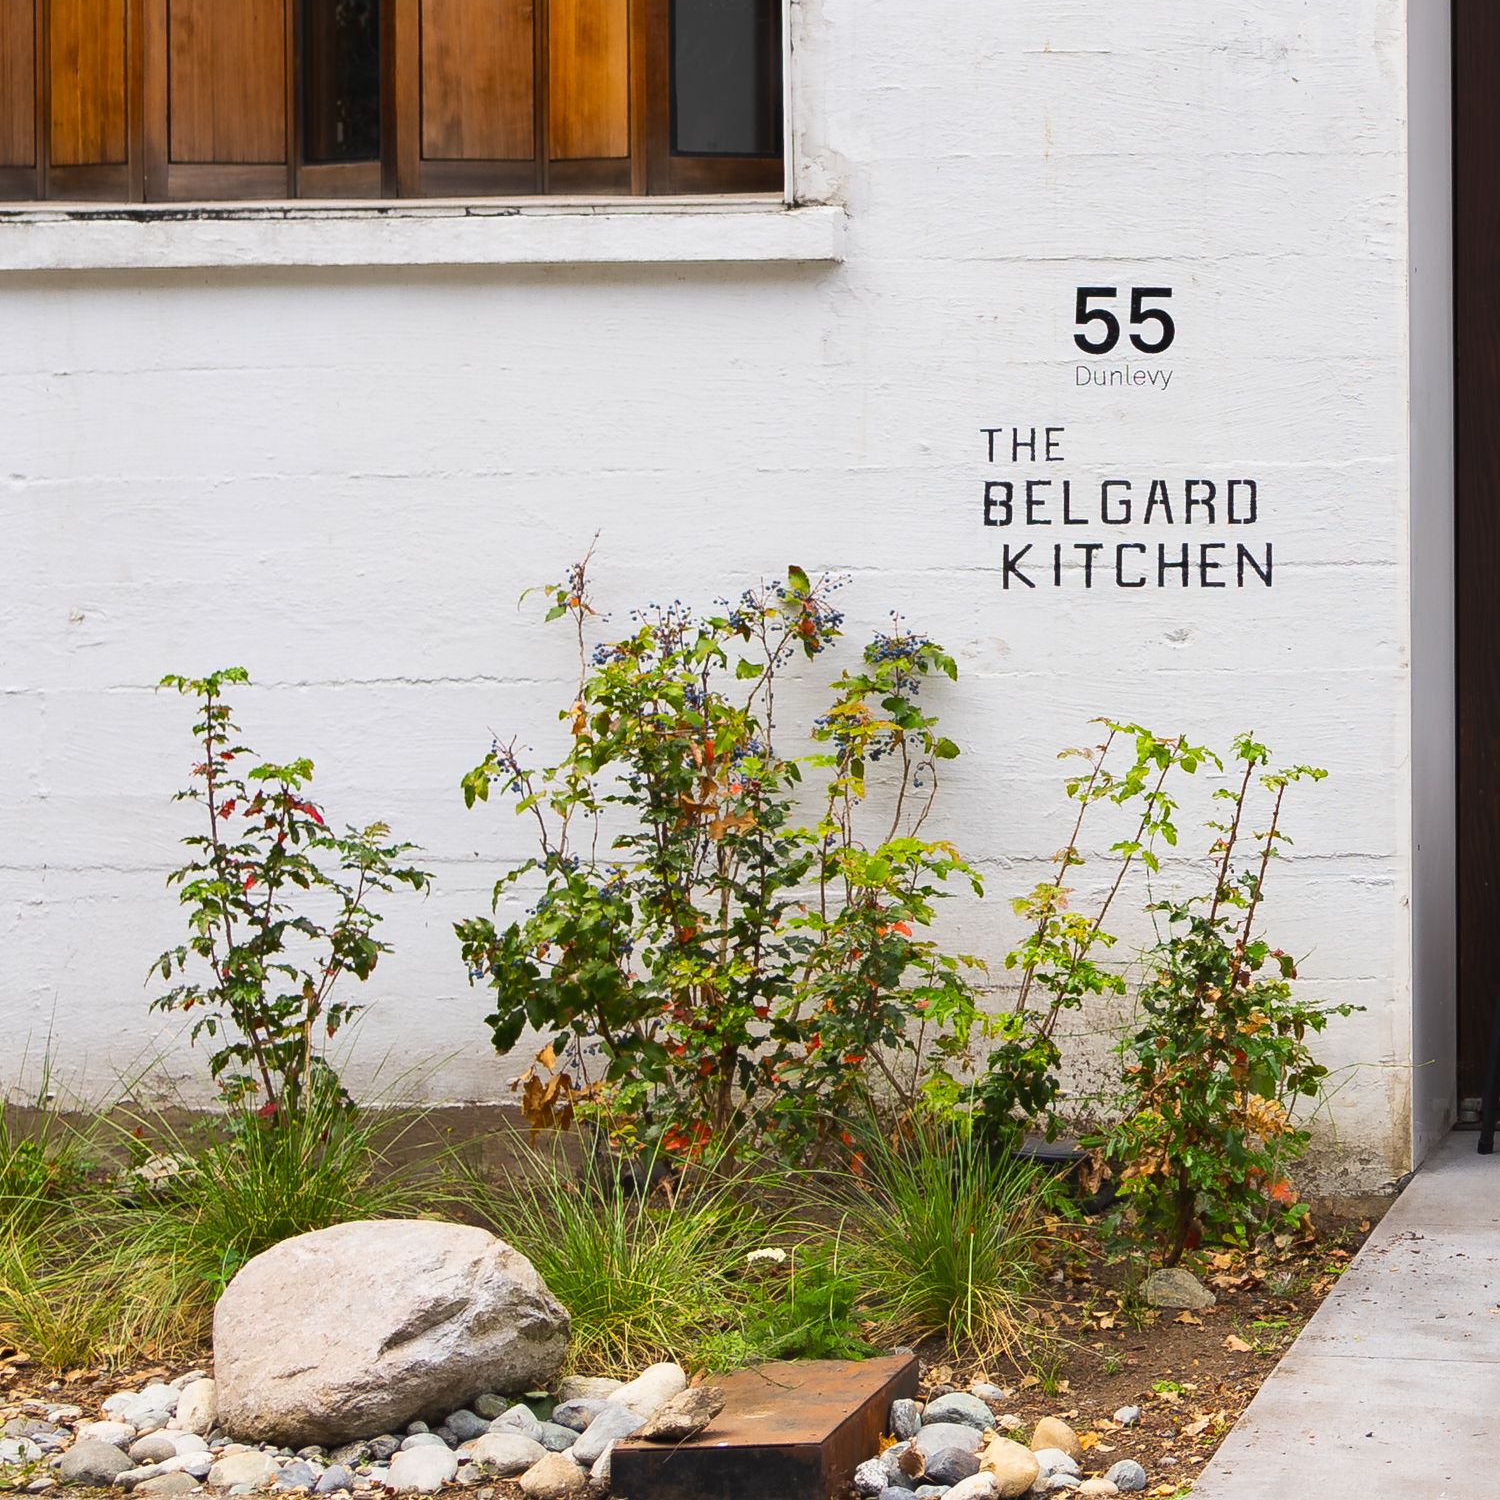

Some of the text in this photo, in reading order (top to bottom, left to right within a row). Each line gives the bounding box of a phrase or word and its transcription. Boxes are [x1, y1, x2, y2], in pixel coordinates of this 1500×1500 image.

[1074, 287, 1175, 354] 55
[1076, 365, 1173, 390] Dunlevy
[980, 428, 1064, 462] THE
[984, 480, 1257, 526] BELGARD
[1003, 543, 1272, 589] KITCHEN
